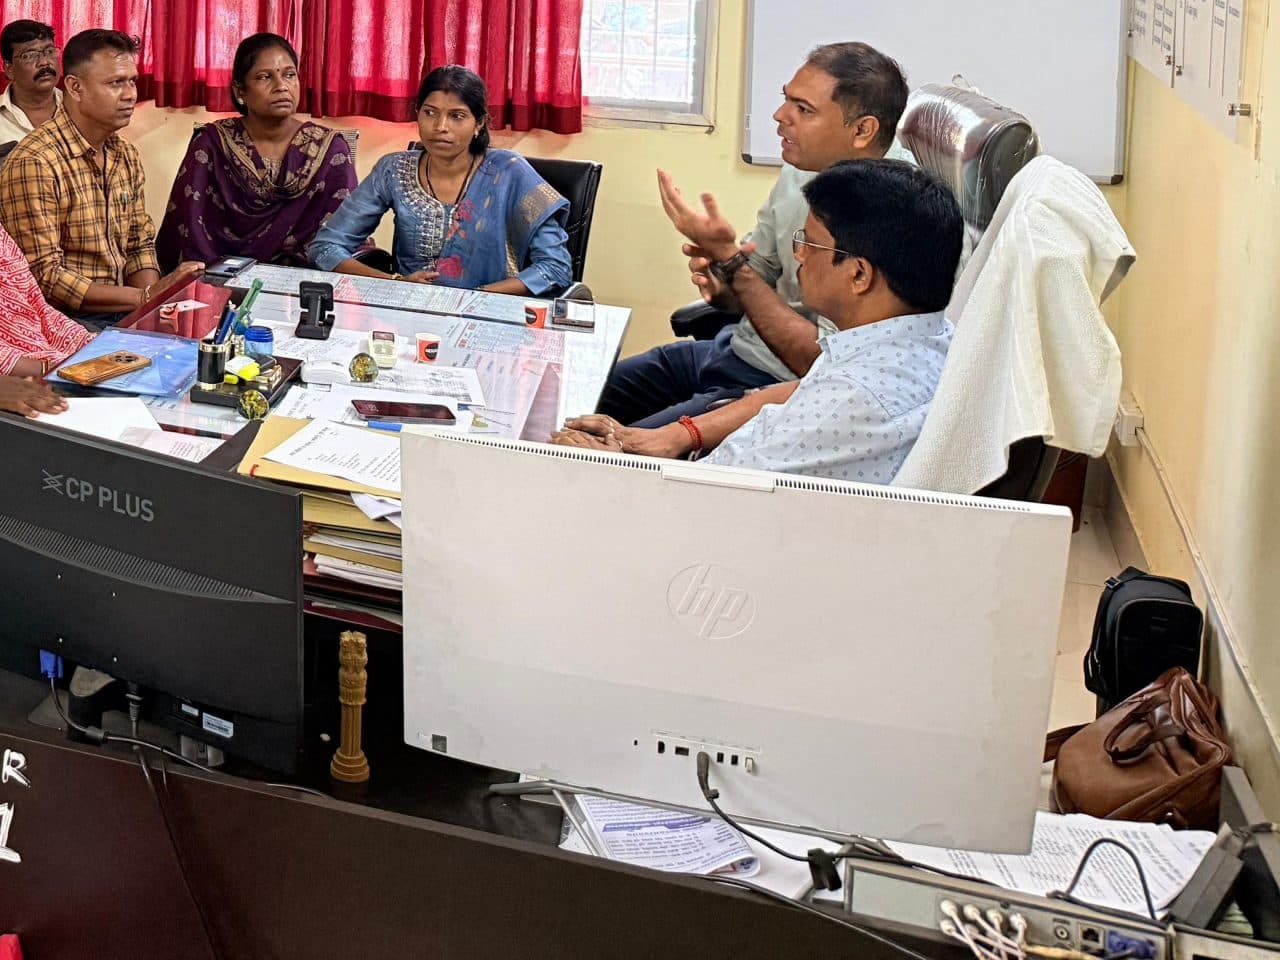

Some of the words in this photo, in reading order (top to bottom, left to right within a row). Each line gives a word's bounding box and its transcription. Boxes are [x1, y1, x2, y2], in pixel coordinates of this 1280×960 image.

[65, 477, 94, 502] CP
[98, 486, 155, 522] PLUS
[676, 562, 749, 638] hp
